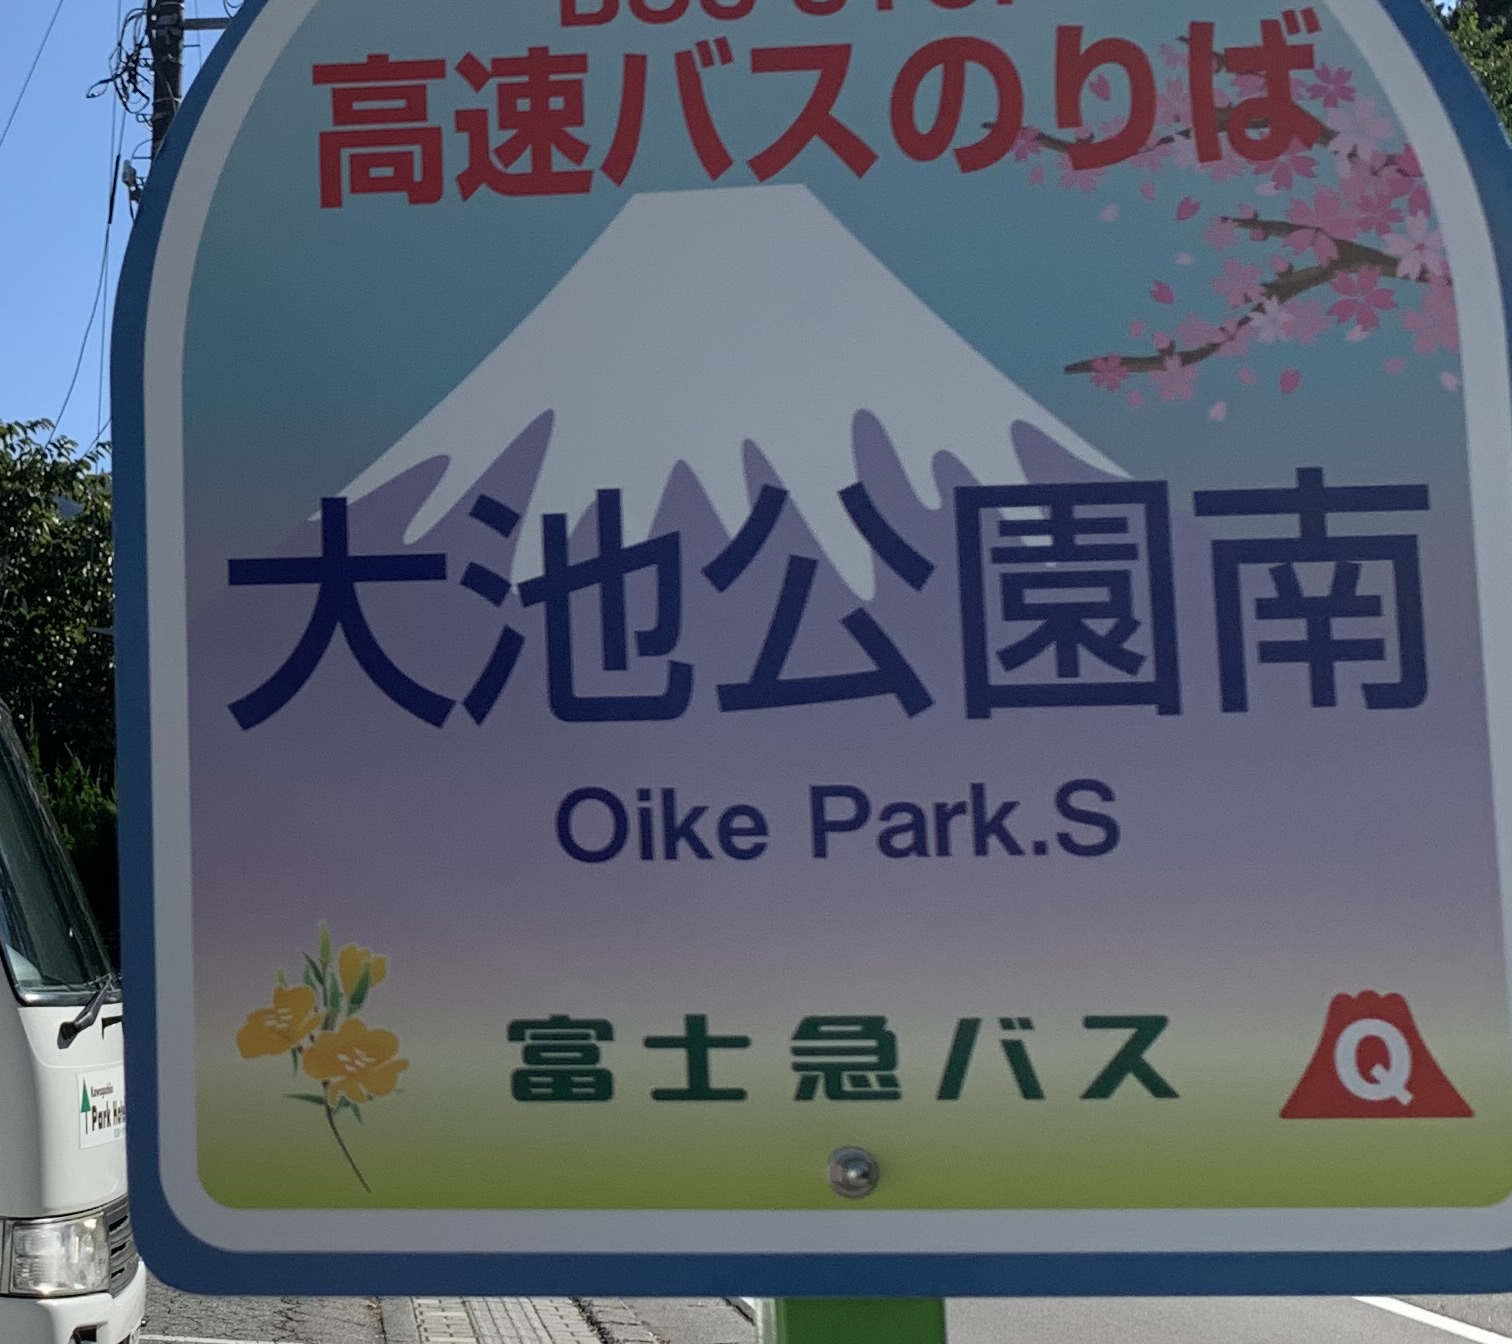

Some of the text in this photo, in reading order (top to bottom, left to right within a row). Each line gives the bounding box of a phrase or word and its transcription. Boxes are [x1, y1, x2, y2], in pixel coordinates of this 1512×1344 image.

[311, 8, 1328, 209] 高速バスのりば
[226, 466, 1431, 733] 大池公園南
[555, 778, 1122, 863] Oike Park.S
[506, 1013, 1181, 1104] 富士急バス
[1333, 1019, 1414, 1107] Q
[92, 1101, 112, 1132] Park
